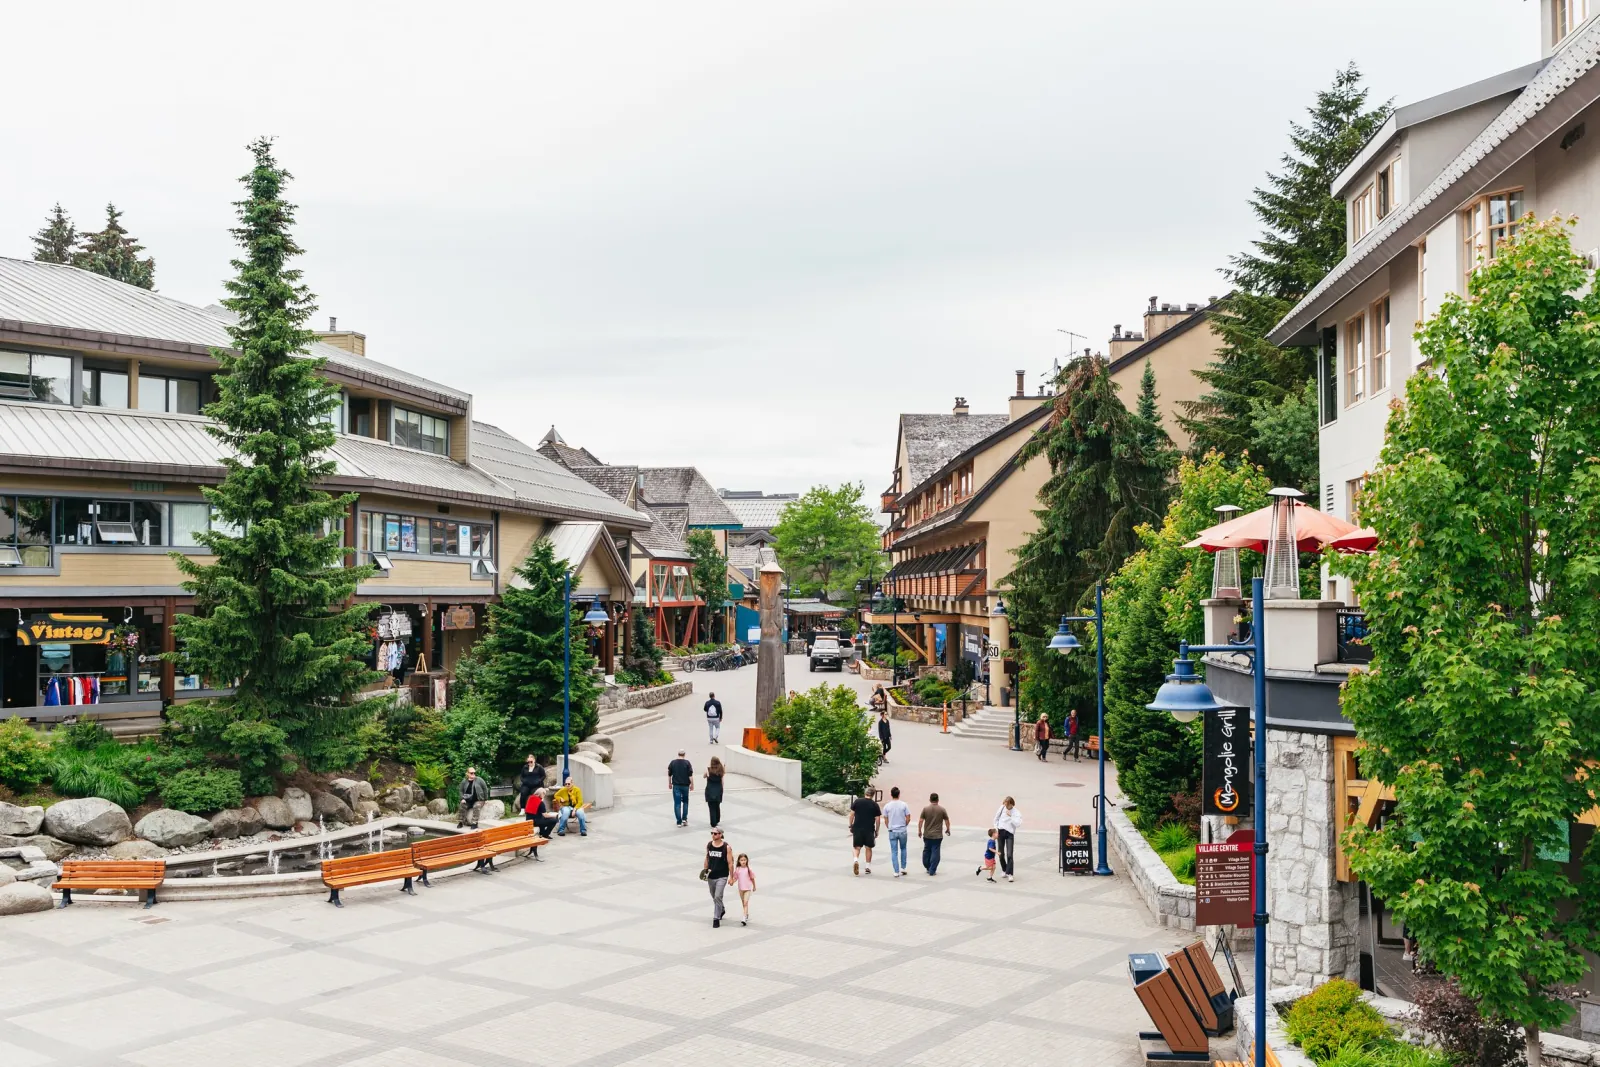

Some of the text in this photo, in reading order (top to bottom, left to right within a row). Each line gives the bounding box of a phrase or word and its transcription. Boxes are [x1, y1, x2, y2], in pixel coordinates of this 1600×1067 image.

[30, 624, 103, 640] Vintage
[1217, 709, 1238, 804] Mongolie Grill
[1198, 844, 1219, 852] VILLAGE
